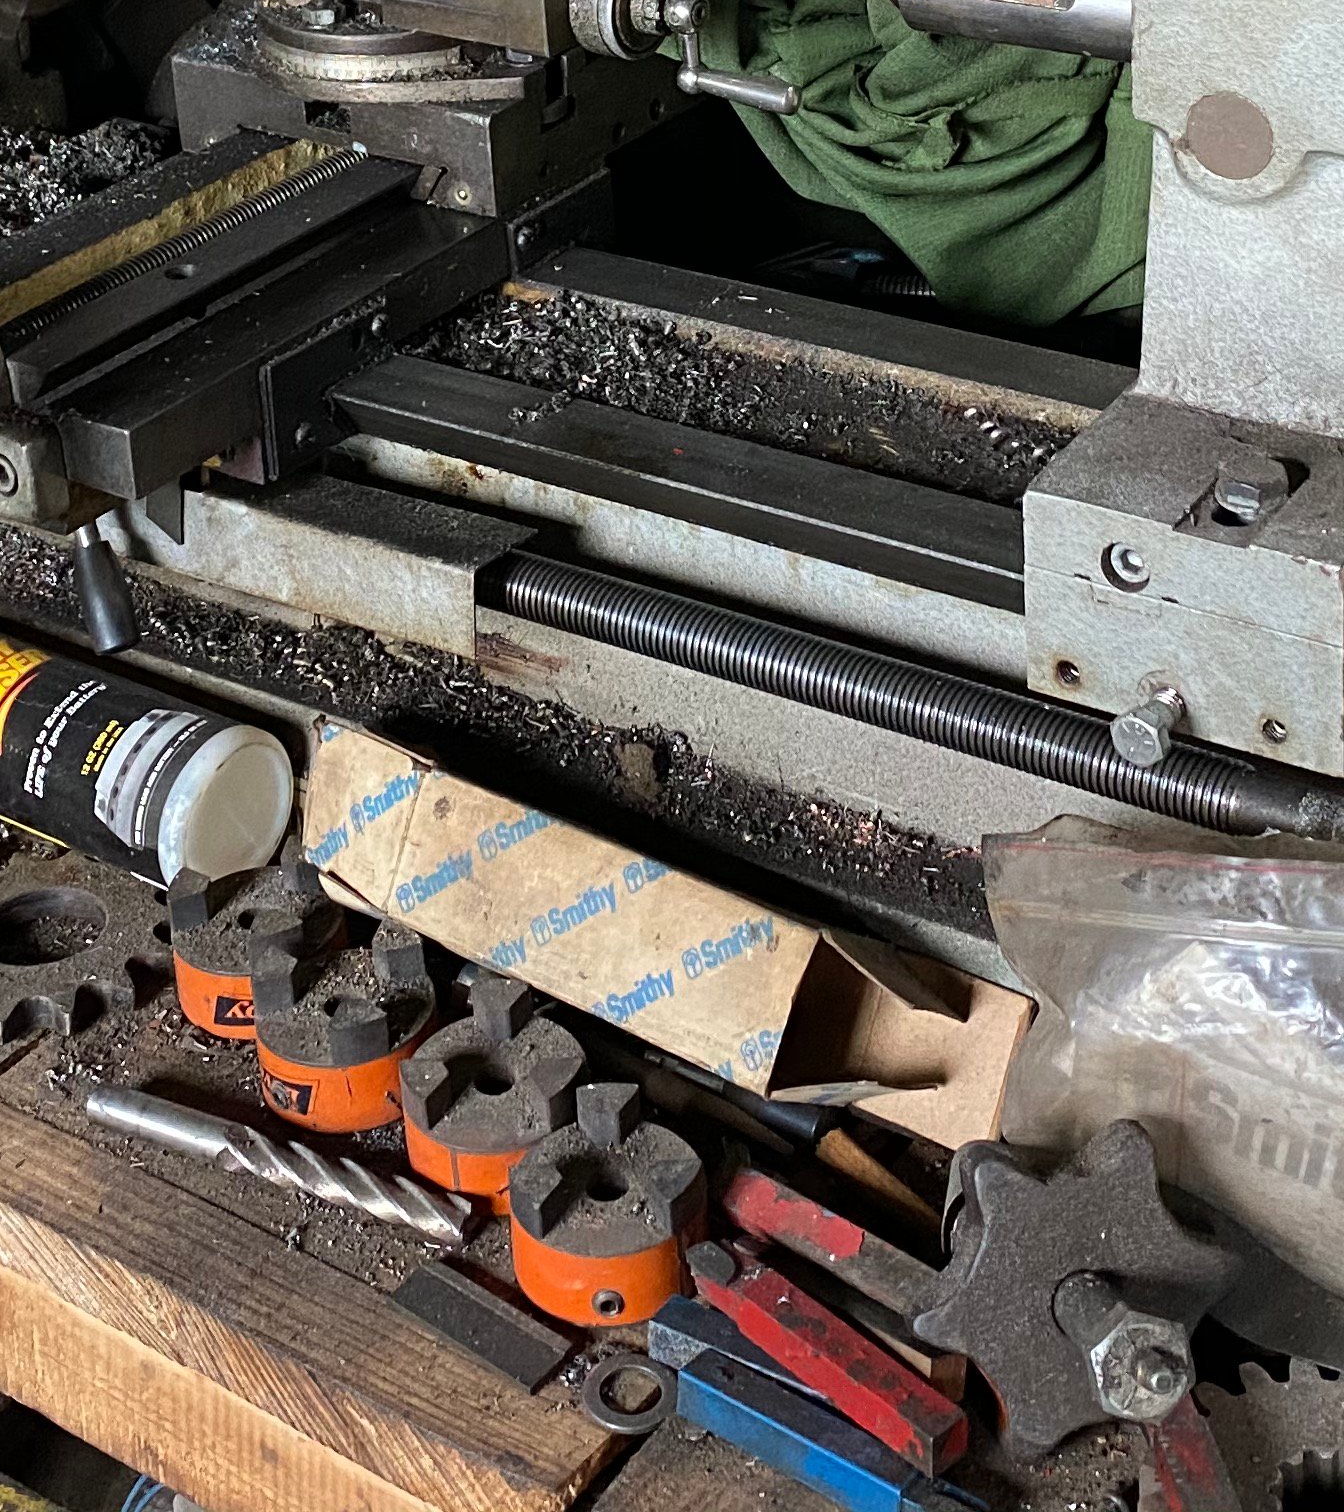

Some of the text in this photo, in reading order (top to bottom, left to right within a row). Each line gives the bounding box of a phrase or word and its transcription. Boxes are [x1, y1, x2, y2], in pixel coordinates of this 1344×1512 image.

[23, 747, 40, 794] Proven
[35, 729, 47, 745] to
[43, 690, 79, 729] Extend
[41, 745, 52, 764] of
[47, 716, 68, 748] your
[362, 770, 420, 822] Smithy
[411, 850, 473, 903] Smithy
[548, 882, 617, 936] Smithy
[701, 915, 774, 968] Smithy
[606, 968, 675, 1023] Smithy
